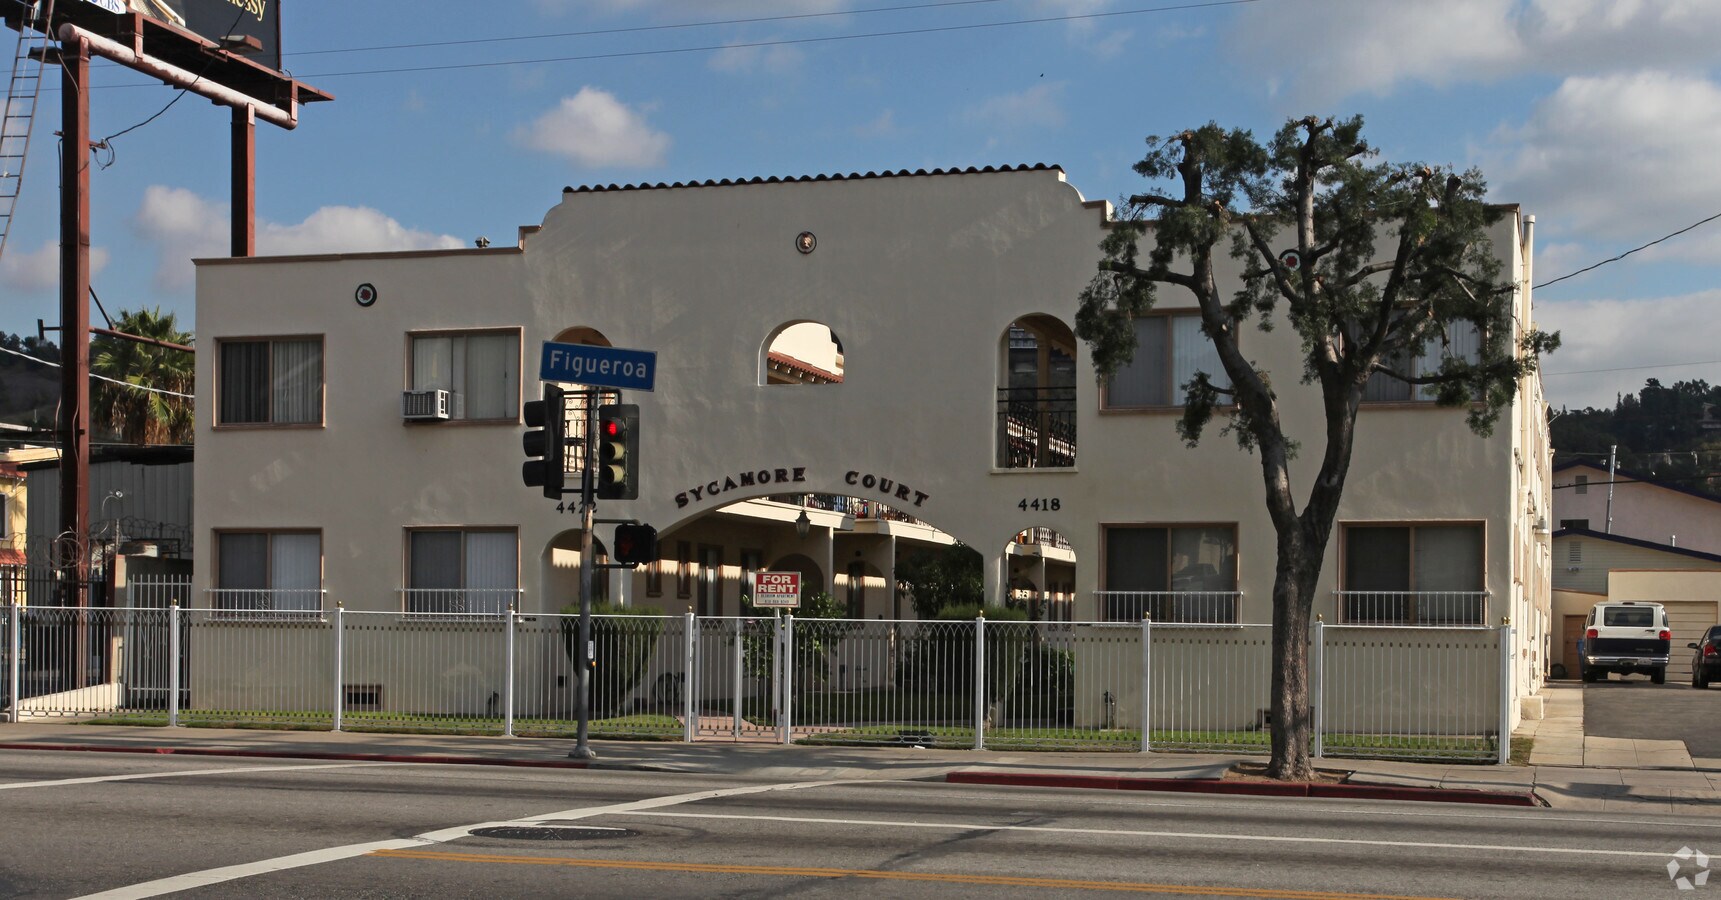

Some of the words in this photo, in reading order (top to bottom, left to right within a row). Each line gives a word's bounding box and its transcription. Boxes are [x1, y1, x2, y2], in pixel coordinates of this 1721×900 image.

[227, 0, 266, 21] ssy
[550, 350, 647, 378] Figueroa
[674, 467, 806, 509] SYCAMORE
[845, 470, 930, 507] COURT
[1018, 498, 1061, 511] 4418
[762, 575, 792, 584] FOR
[757, 584, 796, 593] RENT
